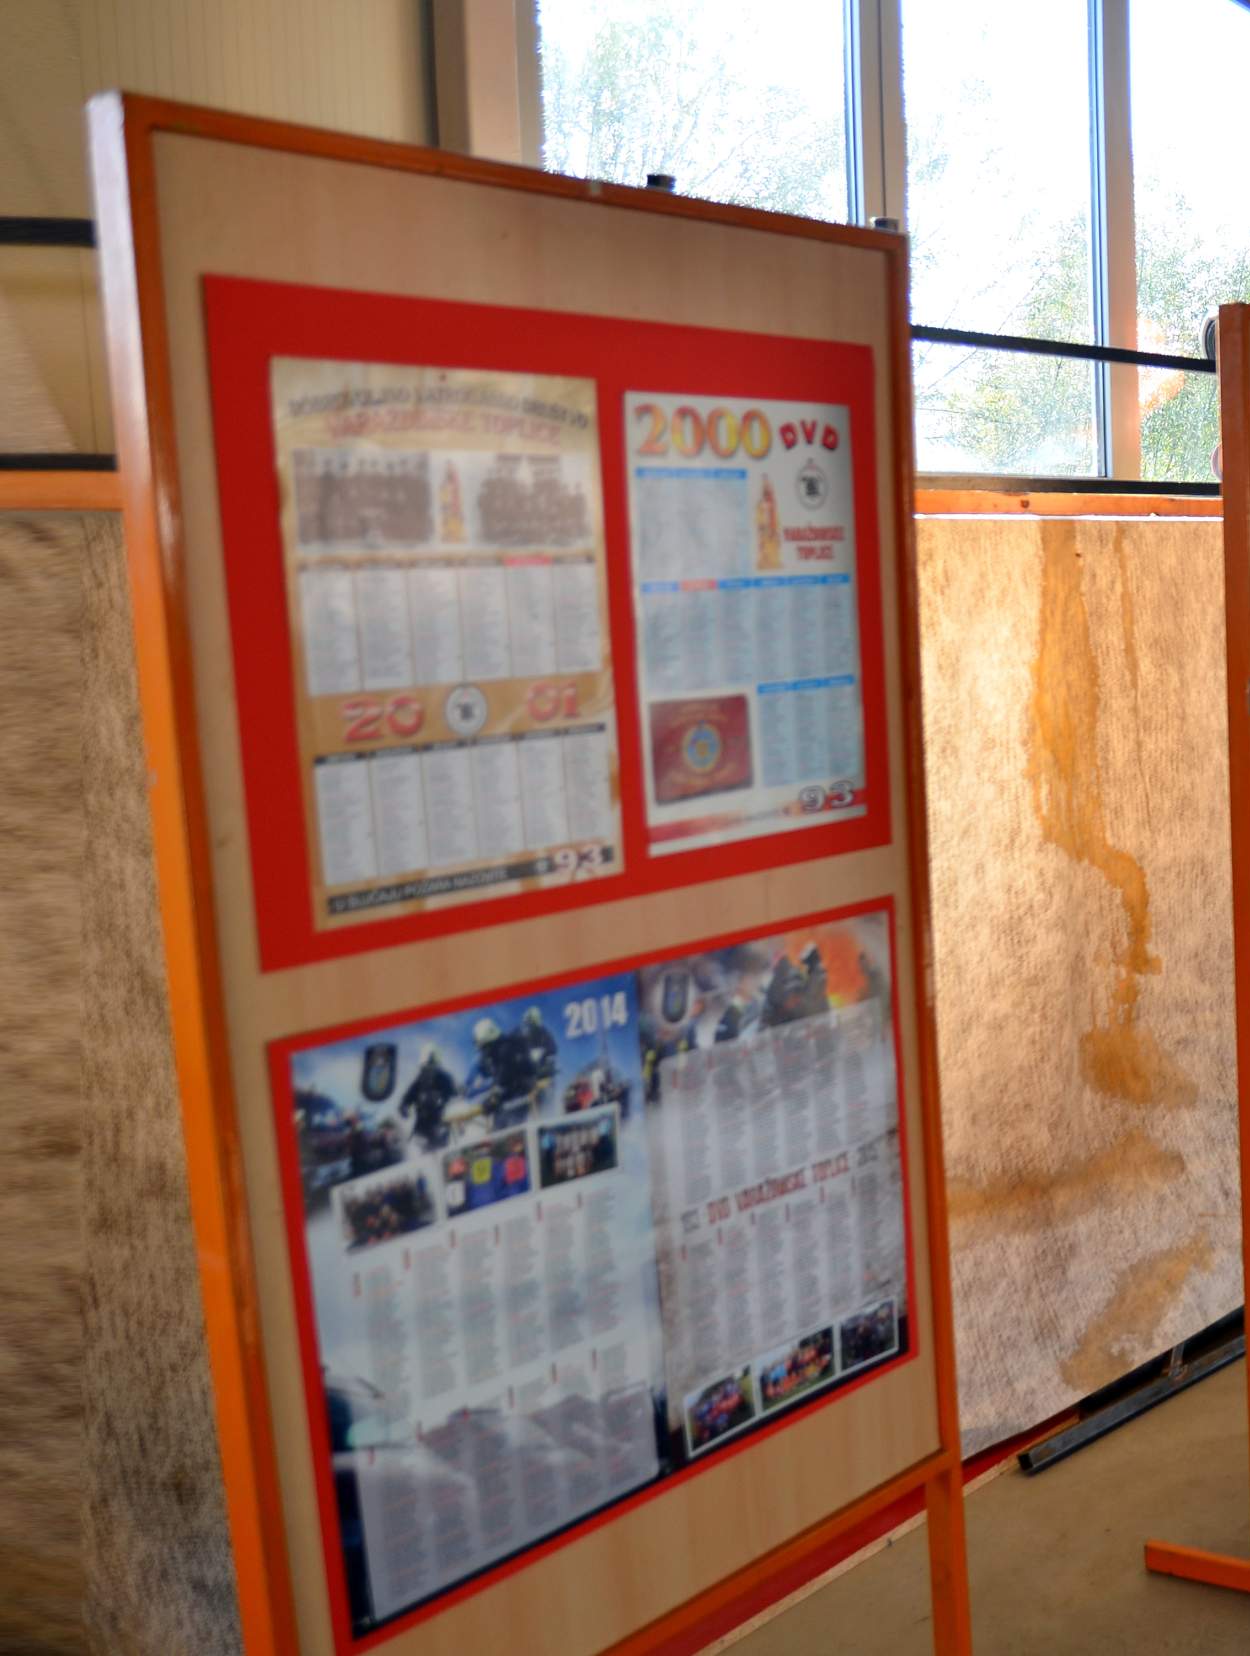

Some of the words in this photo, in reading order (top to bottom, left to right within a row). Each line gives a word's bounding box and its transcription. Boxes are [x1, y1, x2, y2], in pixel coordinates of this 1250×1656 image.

[634, 403, 772, 461] 2000
[779, 419, 839, 451] DVD
[800, 780, 856, 813] 93
[564, 990, 629, 1039] 2014
